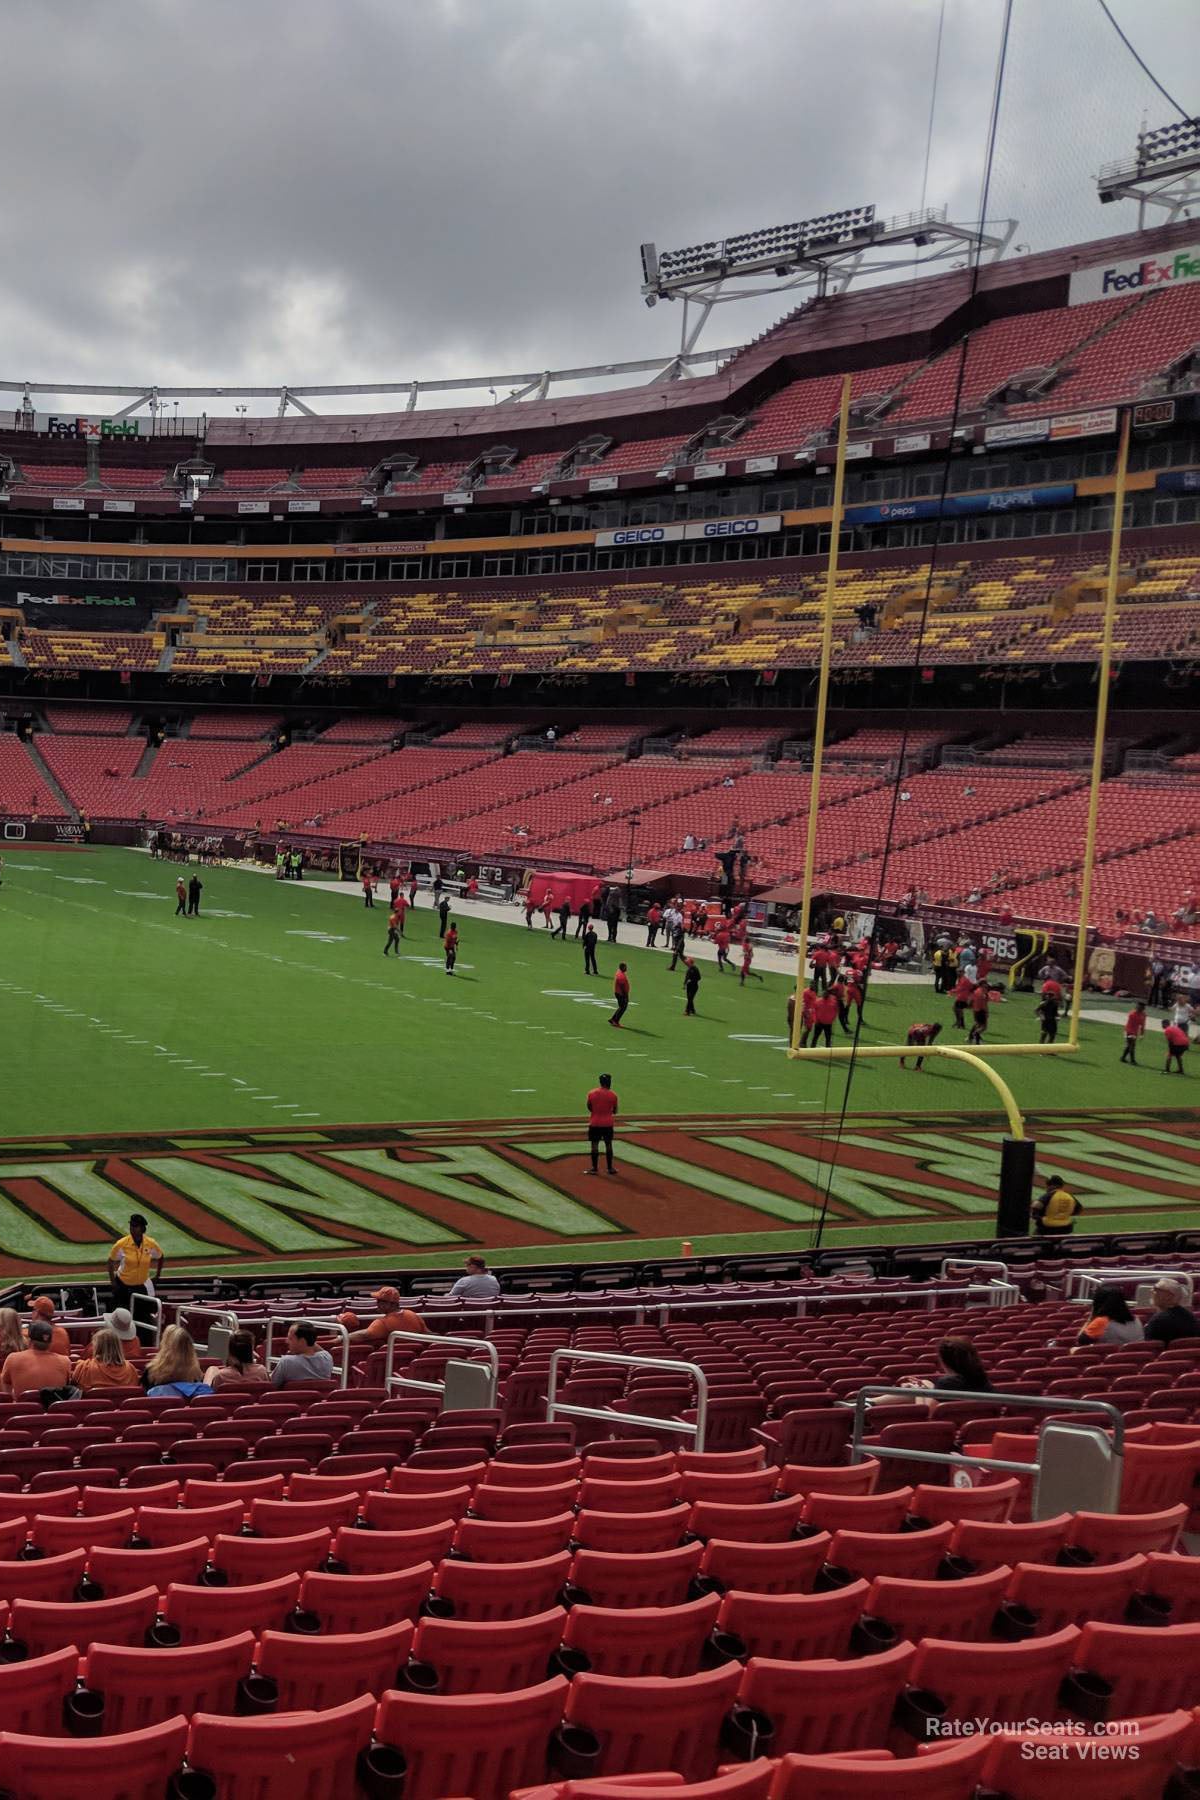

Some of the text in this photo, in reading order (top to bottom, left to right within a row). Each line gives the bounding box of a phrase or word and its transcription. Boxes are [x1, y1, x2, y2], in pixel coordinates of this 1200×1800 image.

[48, 416, 139, 436] FedExField
[890, 506, 916, 517] pepsi
[613, 528, 665, 544] GEICO
[704, 520, 759, 536] GEICO
[16, 591, 137, 606] FedExField
